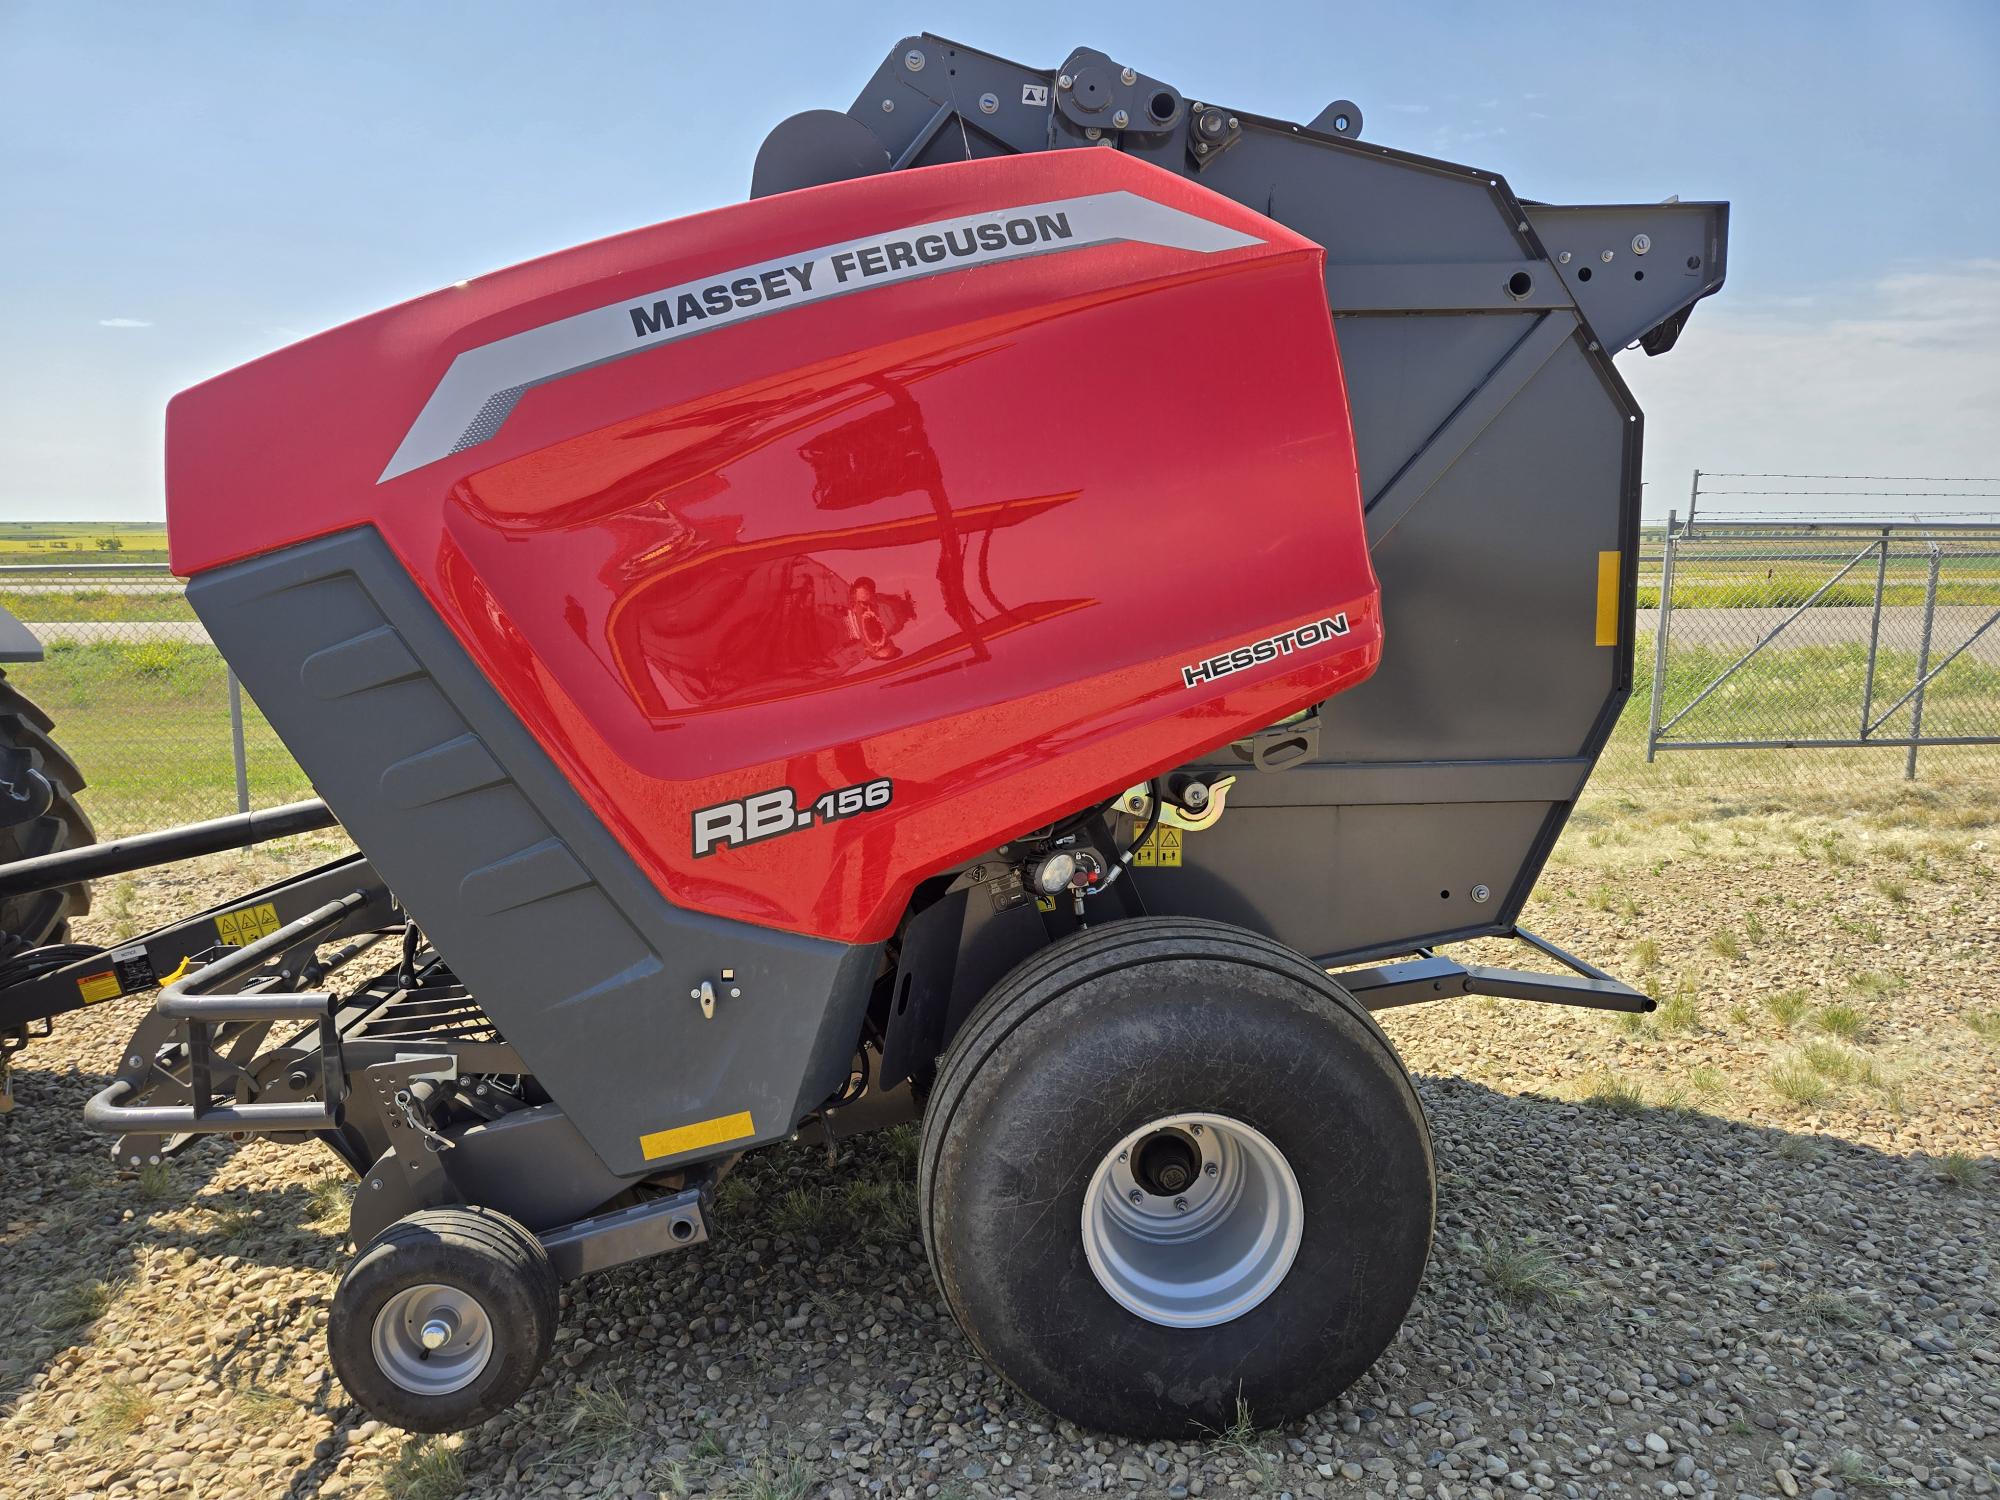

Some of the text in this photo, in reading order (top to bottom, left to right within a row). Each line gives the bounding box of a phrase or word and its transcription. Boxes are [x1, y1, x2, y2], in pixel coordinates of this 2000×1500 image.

[629, 212, 1073, 337] MASSEY FERGUSON
[1183, 613, 1349, 687] HESSTON
